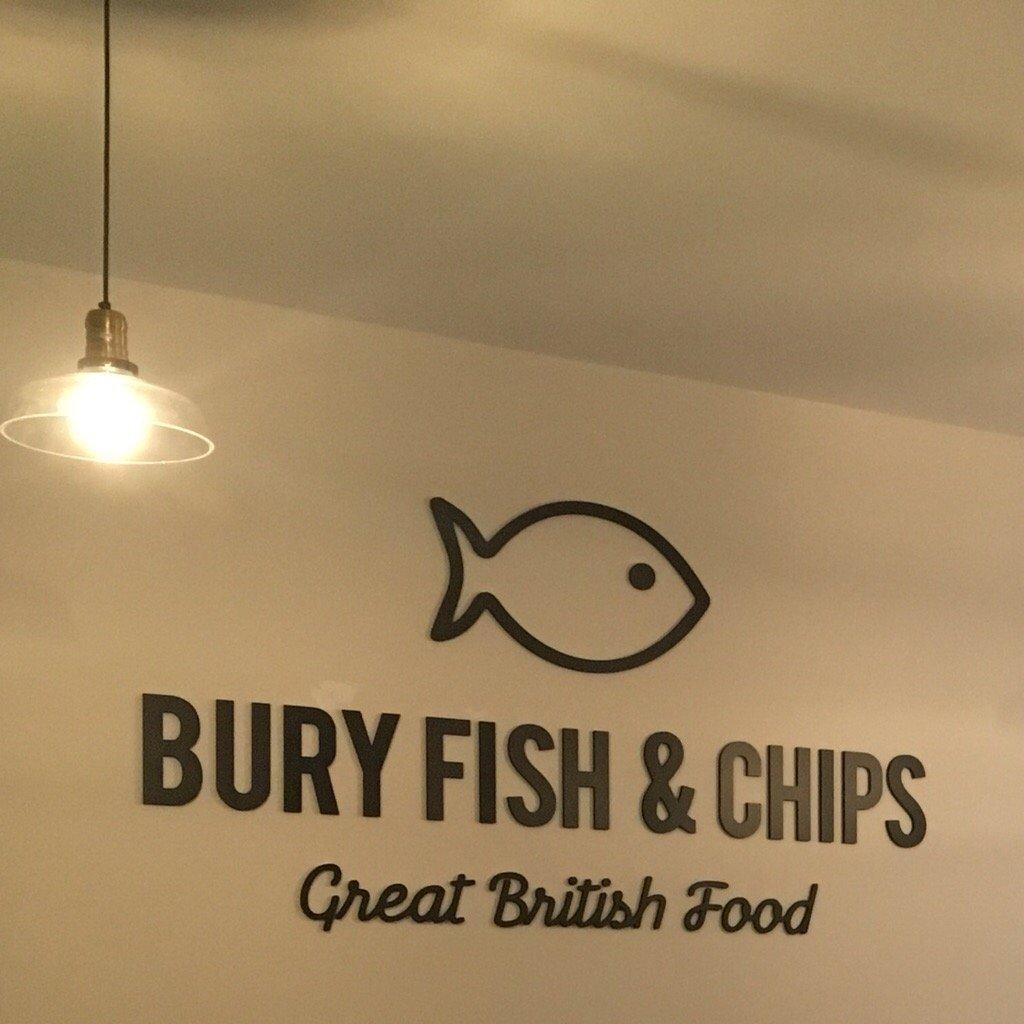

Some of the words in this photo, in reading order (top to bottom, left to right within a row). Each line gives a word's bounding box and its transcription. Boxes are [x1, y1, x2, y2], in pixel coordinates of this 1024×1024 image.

[142, 693, 400, 818] BURY
[425, 717, 610, 831] FISH
[640, 731, 697, 834] &
[717, 742, 927, 849] CHIPS
[299, 864, 476, 933] Great
[488, 871, 666, 931] British
[683, 881, 819, 936] Food
